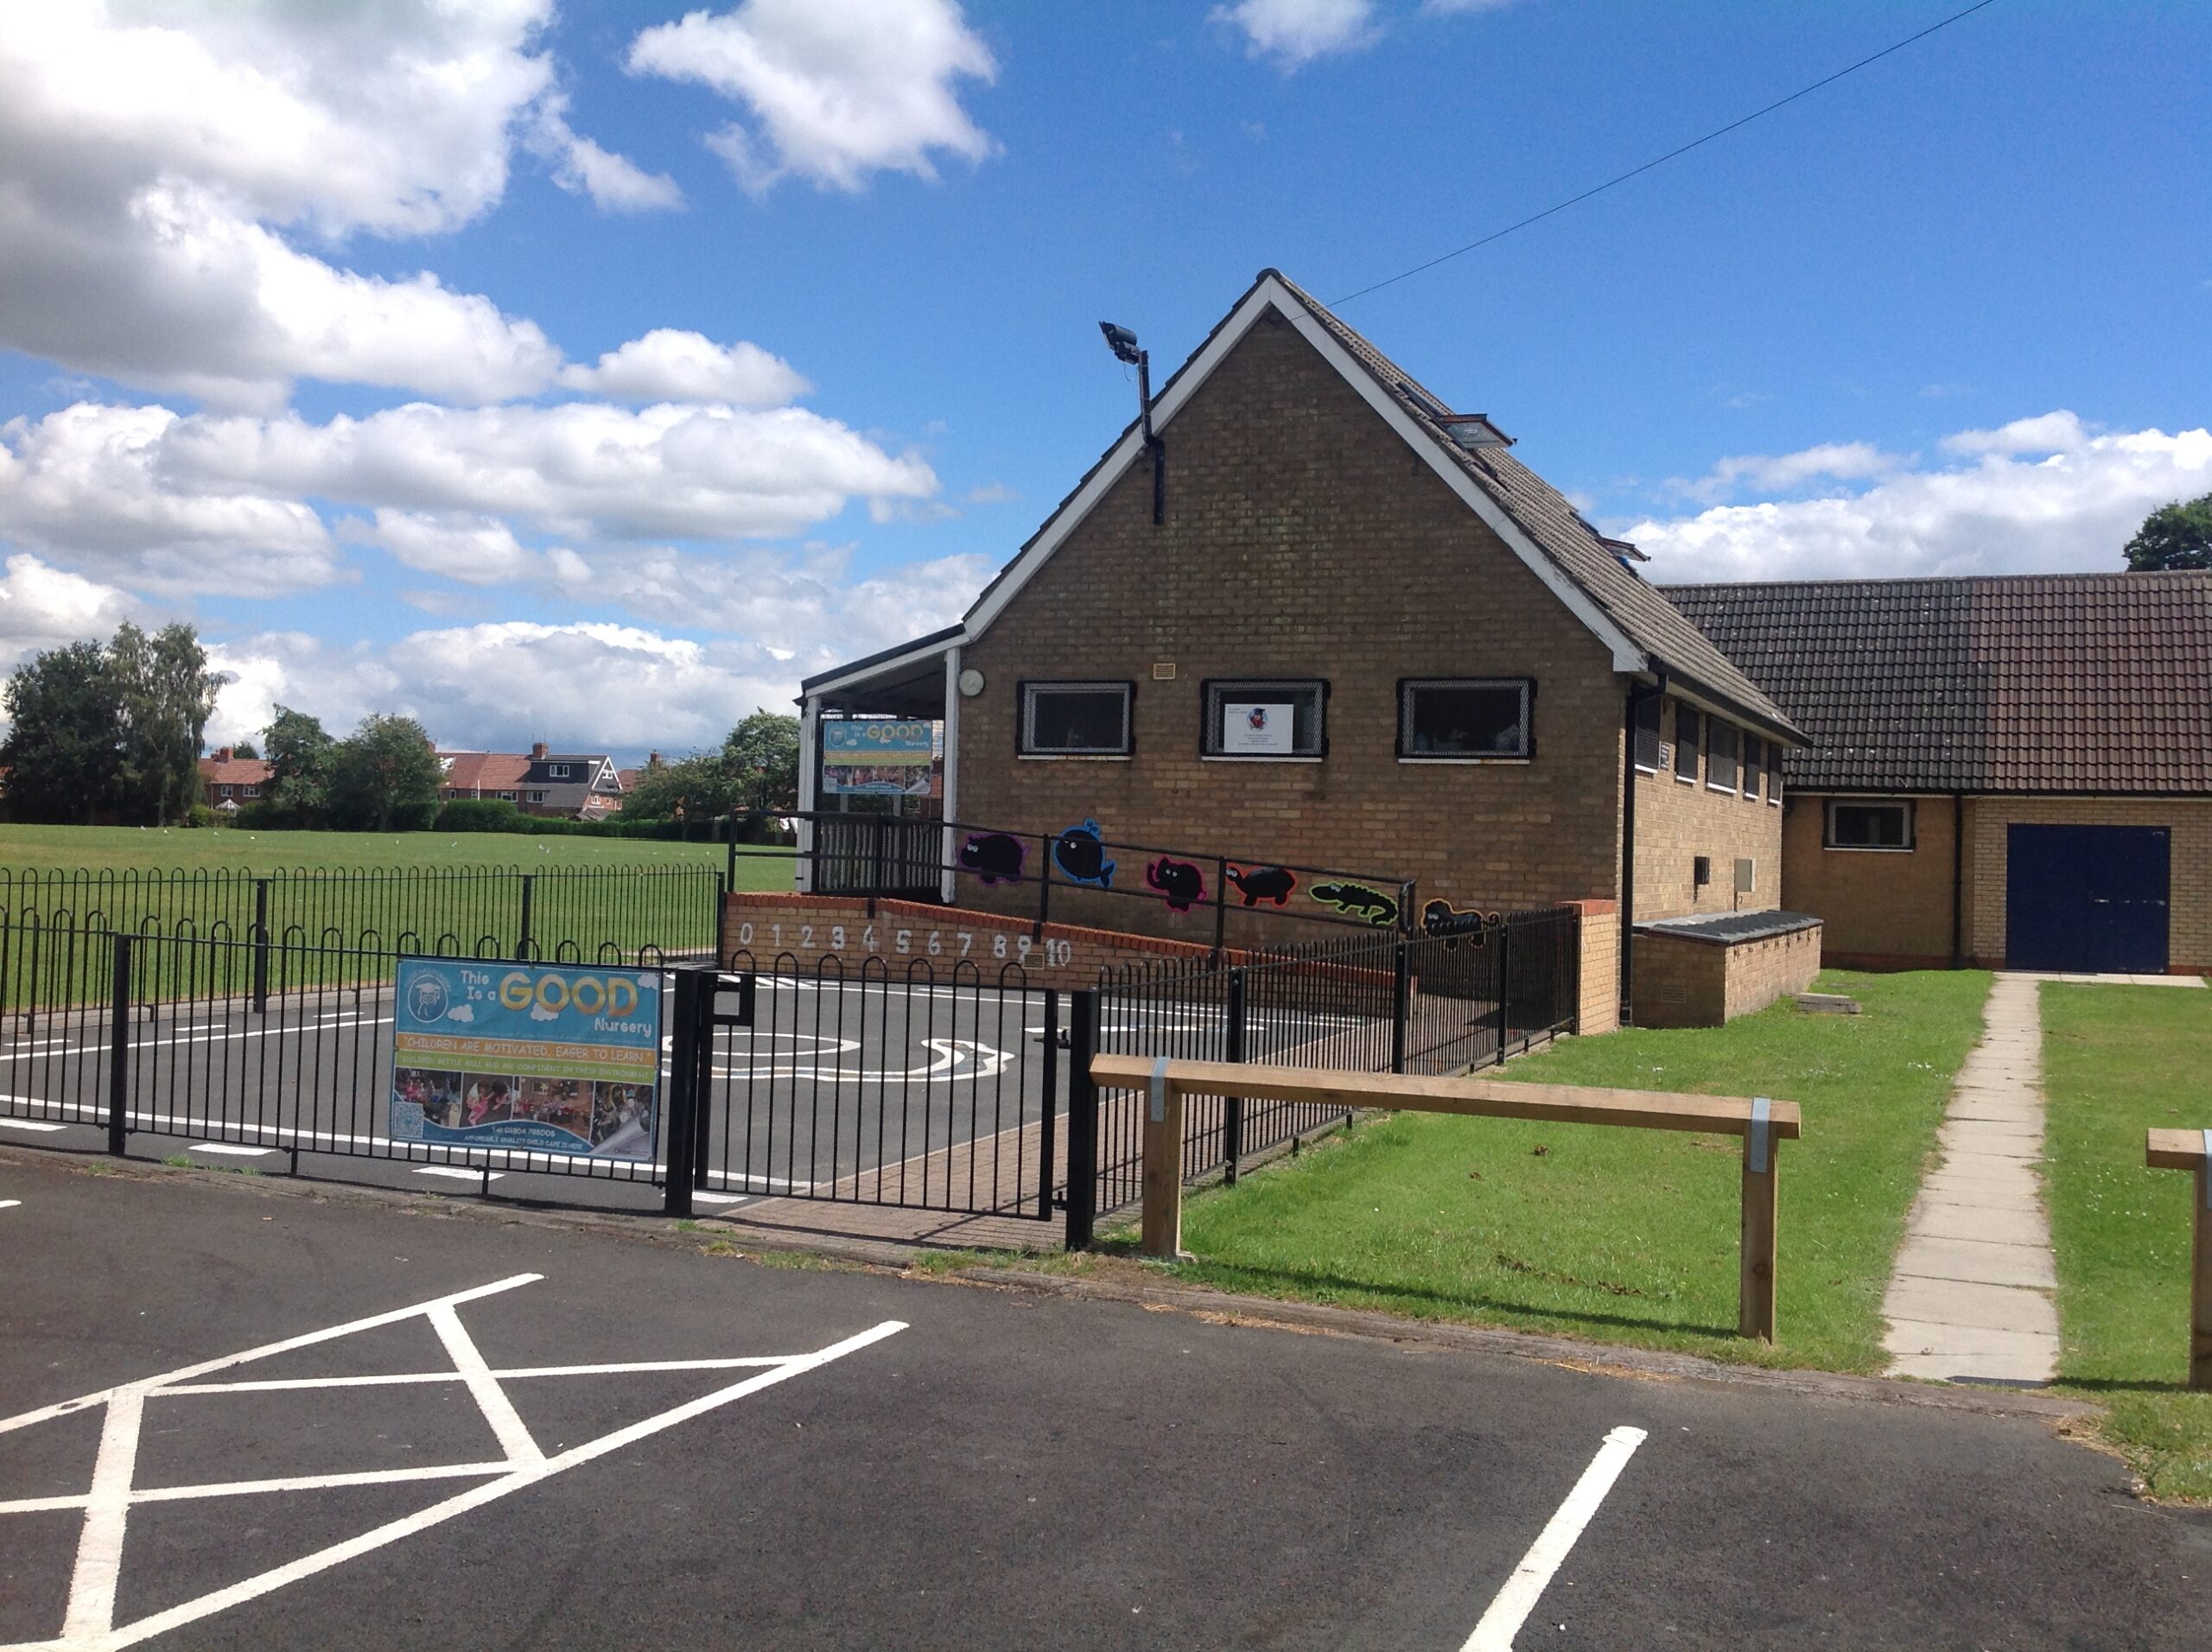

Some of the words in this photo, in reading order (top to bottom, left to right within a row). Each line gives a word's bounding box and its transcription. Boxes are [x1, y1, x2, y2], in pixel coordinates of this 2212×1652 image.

[867, 724, 924, 740] GOOD
[740, 922, 753, 945] 0
[772, 924, 781, 947] 1
[801, 925, 817, 949] 2
[831, 925, 845, 950] 3
[862, 924, 880, 952] 4
[896, 930, 912, 954] 5
[928, 931, 942, 956] 6
[957, 932, 972, 956] 7
[994, 934, 1007, 958] 8
[1018, 935, 1033, 964] 9
[1046, 938, 1071, 967] 10
[460, 969, 491, 985] This
[467, 986, 484, 1001] Is
[487, 991, 496, 1001] a
[499, 971, 639, 1017] GOOD
[594, 1016, 652, 1038] Nursery
[461, 1041, 480, 1052] ARE
[556, 1046, 588, 1058] EAGER
[594, 1049, 607, 1059] TO
